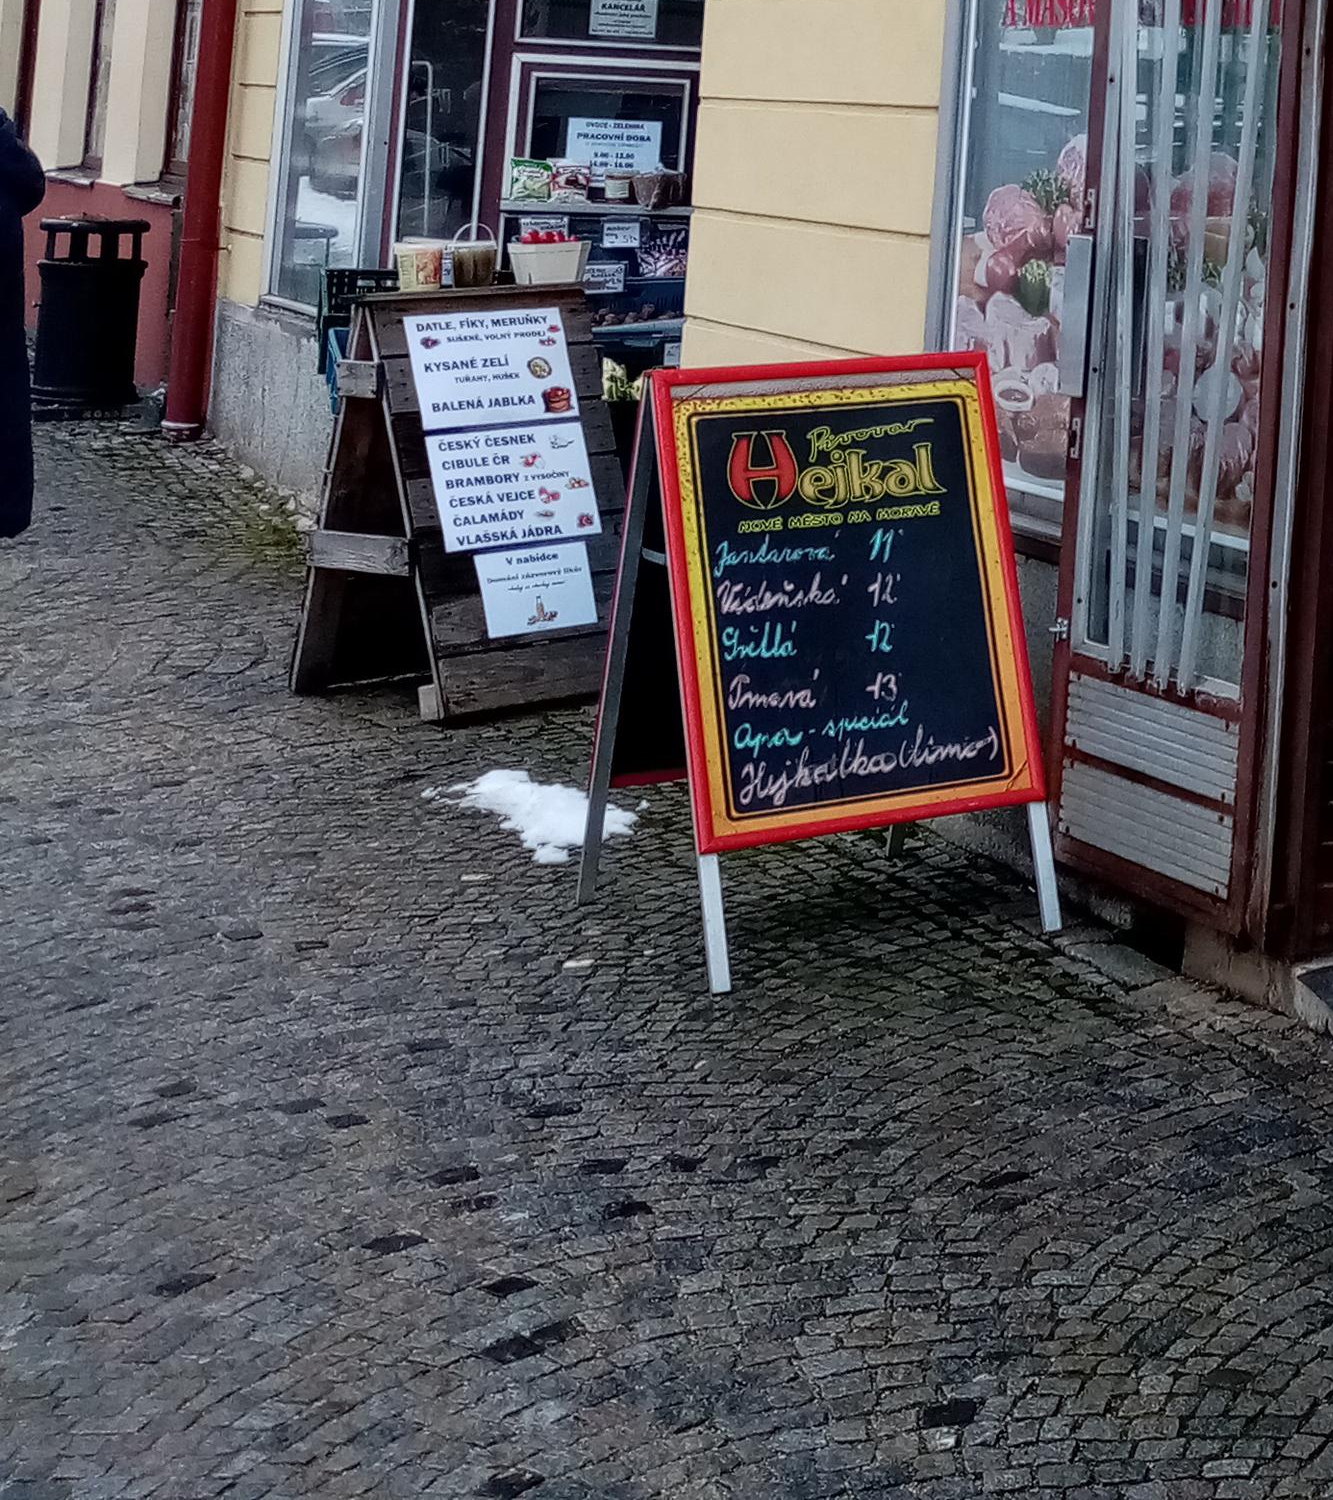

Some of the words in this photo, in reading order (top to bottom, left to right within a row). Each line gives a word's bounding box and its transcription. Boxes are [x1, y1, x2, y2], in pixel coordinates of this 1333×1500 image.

[576, 132, 625, 141] PRACOVNÍ
[626, 134, 652, 142] DOBA
[416, 321, 457, 332] DATLE,
[459, 317, 489, 330] FÍKY,
[491, 314, 548, 327] MERUŇKY
[424, 356, 478, 373] KYSANÉ
[481, 354, 510, 368] ZELÍ
[432, 395, 486, 413] BALENÁ
[487, 395, 536, 409] JABLKA
[438, 436, 481, 452] ČESKÝ
[485, 434, 536, 449] ČESNEK
[806, 418, 934, 462] Pivovar
[442, 456, 490, 470] CIBULE
[492, 453, 511, 465] ČR
[727, 430, 948, 510] Hejkal
[445, 472, 520, 489] BRAMBORY
[449, 490, 494, 508] ČESKÁ
[497, 490, 536, 502] VEJCE
[453, 509, 525, 527] ČALAMÁDY
[848, 511, 872, 524] NA
[456, 528, 518, 546] VLAŠSKÁ
[521, 524, 563, 540] JÁDRA
[728, 668, 820, 710] Tmavá
